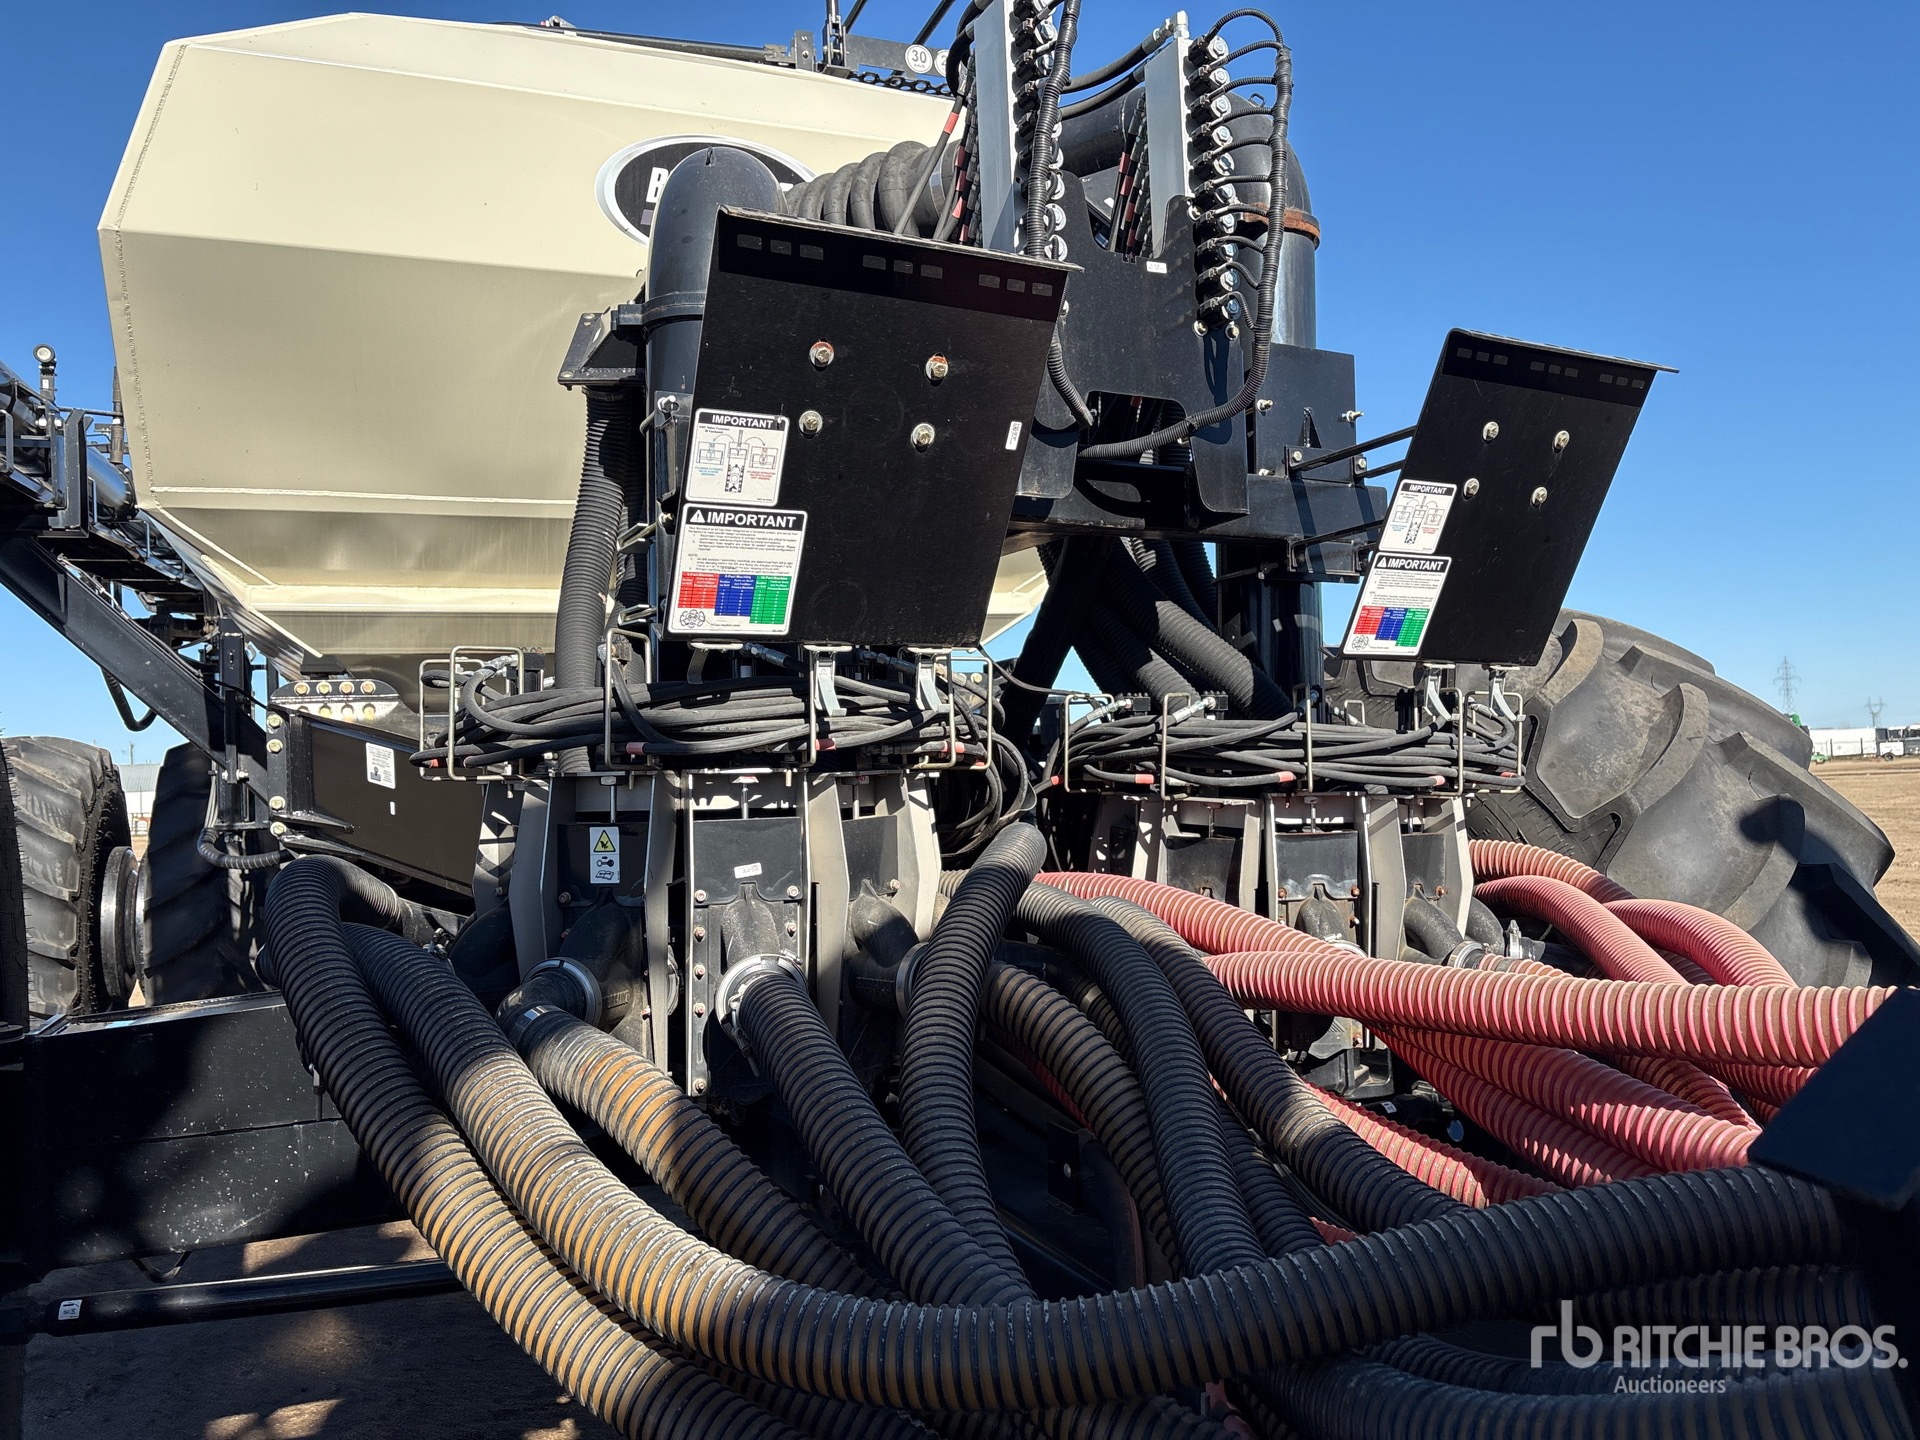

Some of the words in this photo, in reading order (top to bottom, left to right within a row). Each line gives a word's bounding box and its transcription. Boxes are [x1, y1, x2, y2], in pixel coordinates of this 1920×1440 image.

[911, 49, 927, 64] 30
[711, 414, 774, 429] IMPORTANT
[1408, 484, 1448, 495] IMPORTANT
[707, 511, 797, 528] IMPORTANT
[1387, 558, 1445, 571] IMPORTANT
